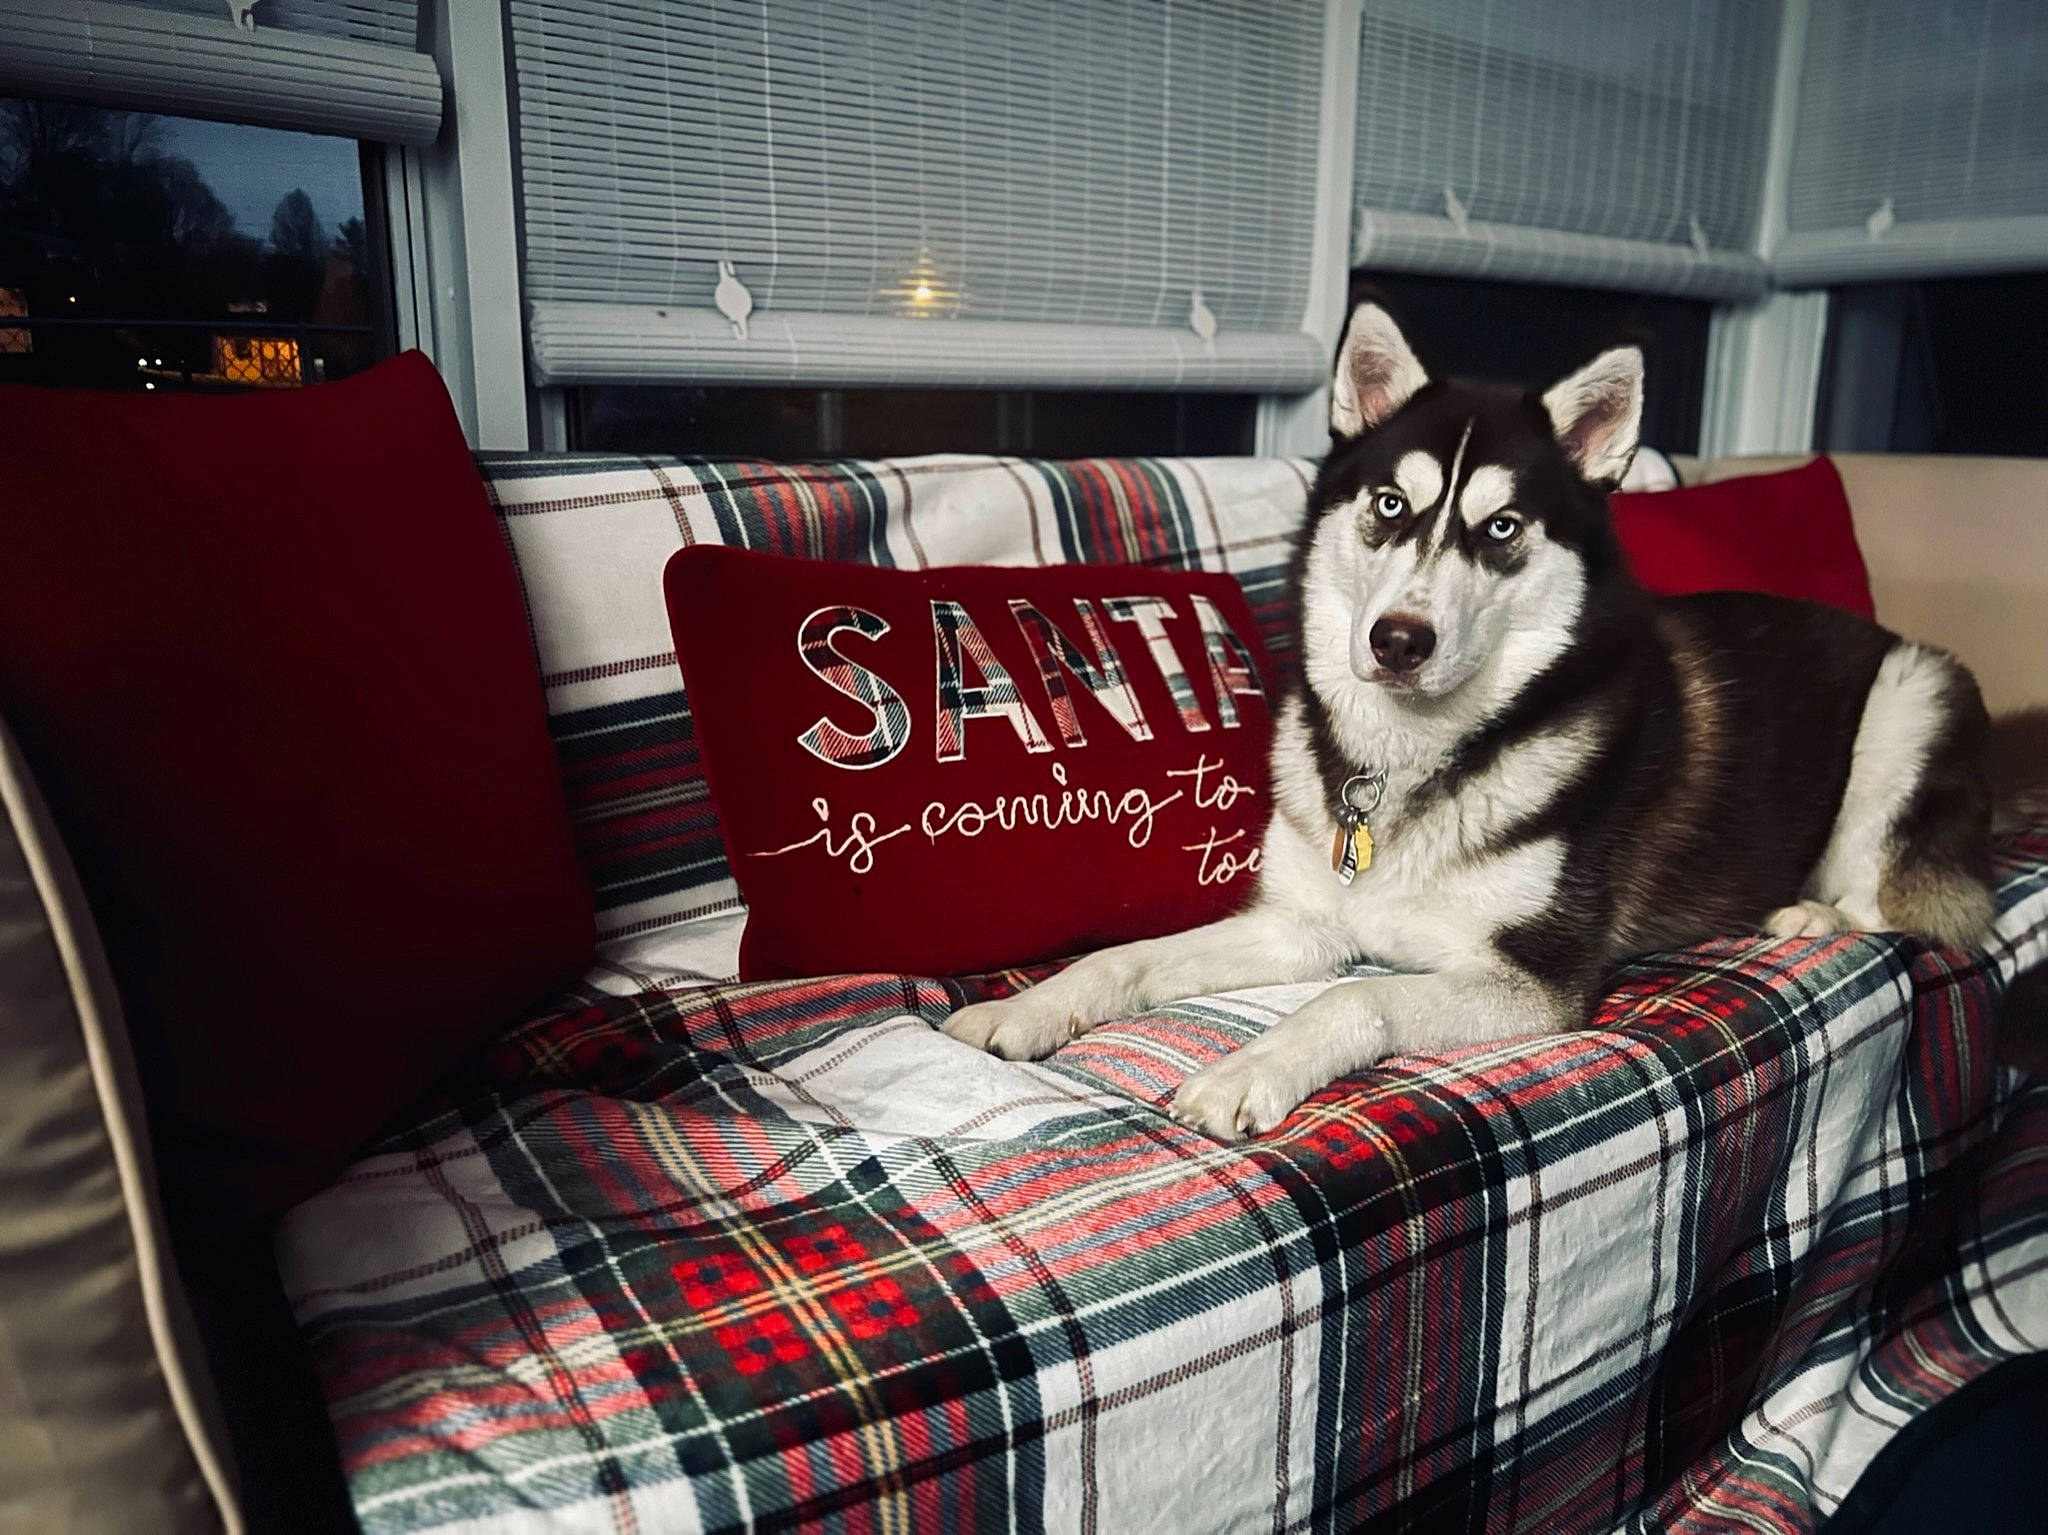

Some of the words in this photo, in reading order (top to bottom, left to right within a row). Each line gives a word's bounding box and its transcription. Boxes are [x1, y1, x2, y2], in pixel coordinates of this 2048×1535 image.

[797, 594, 1265, 771] SANTA
[746, 797, 911, 875] is
[922, 762, 1184, 848] coming
[1167, 753, 1256, 811] to
